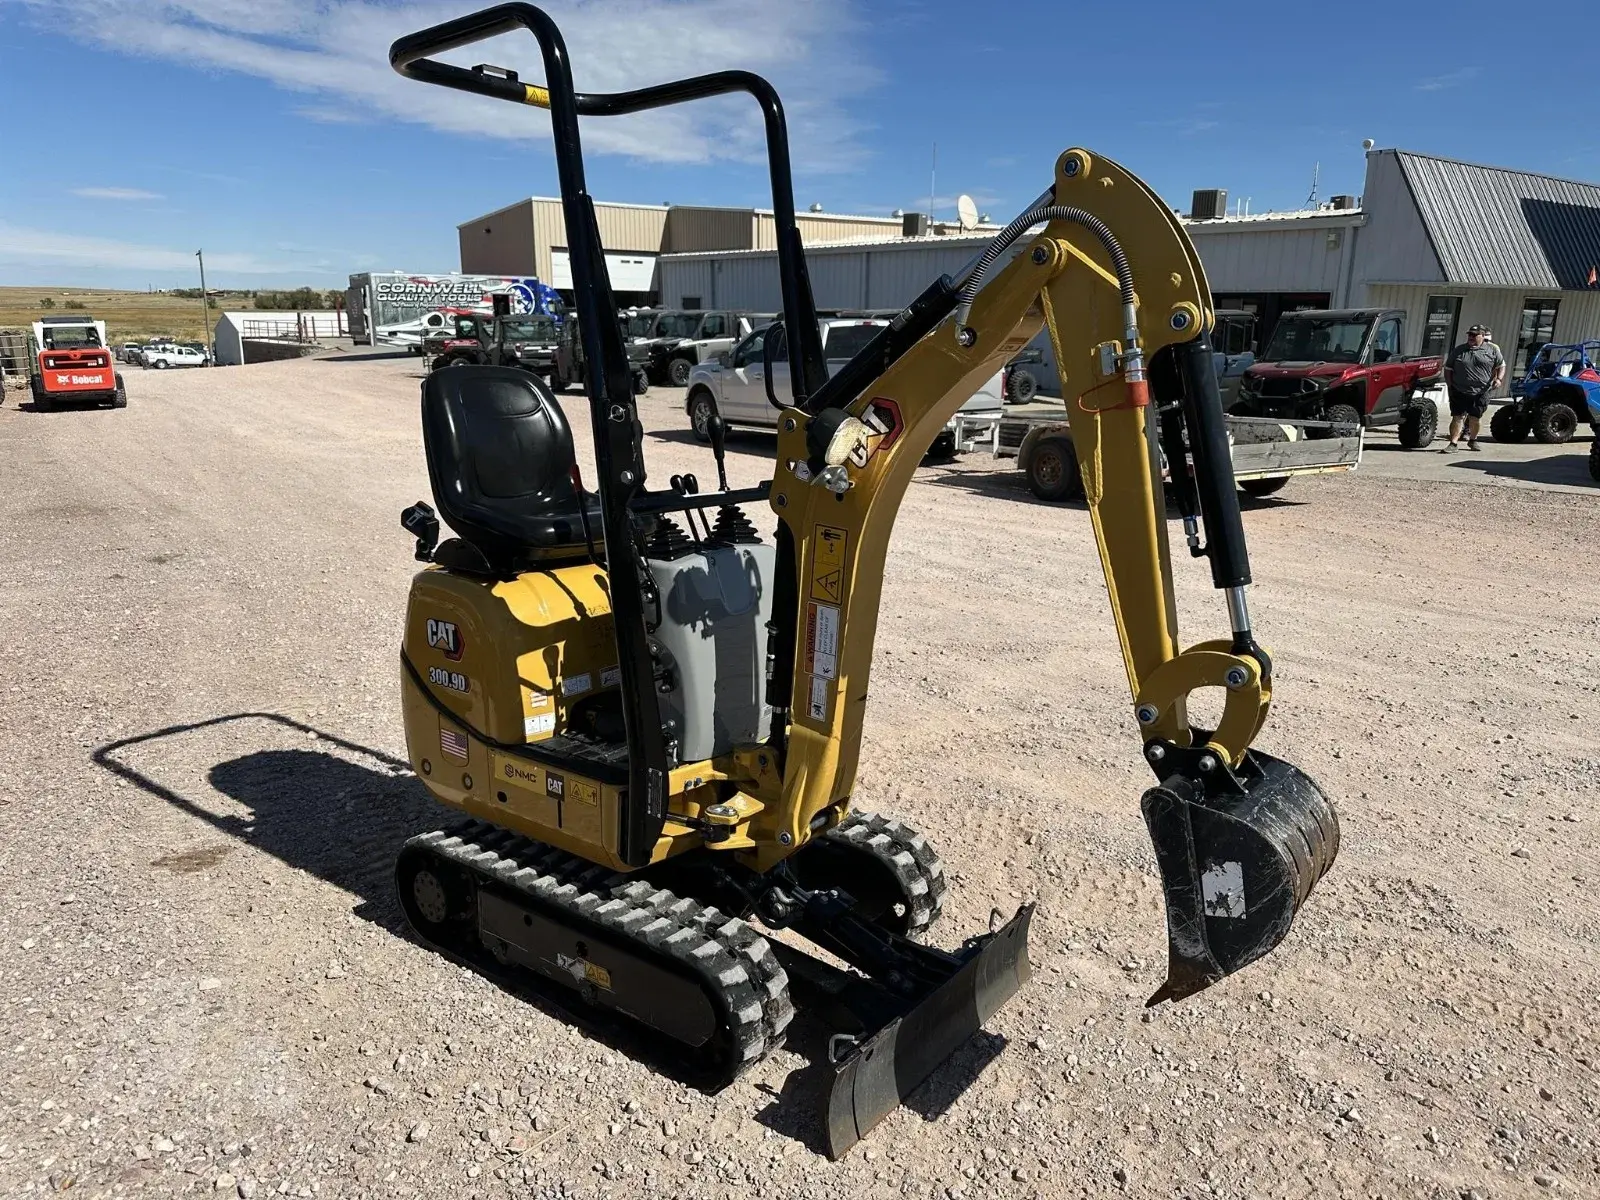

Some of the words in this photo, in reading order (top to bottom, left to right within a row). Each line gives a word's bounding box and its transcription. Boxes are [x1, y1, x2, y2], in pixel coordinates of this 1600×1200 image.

[378, 284, 482, 293] CORNWELL
[71, 375, 103, 385] Bobcat
[427, 619, 455, 651] CAT
[807, 613, 815, 655] WARNING
[429, 667, 466, 691] 300.9D
[515, 768, 537, 783] NMC
[547, 777, 563, 795] CAT
